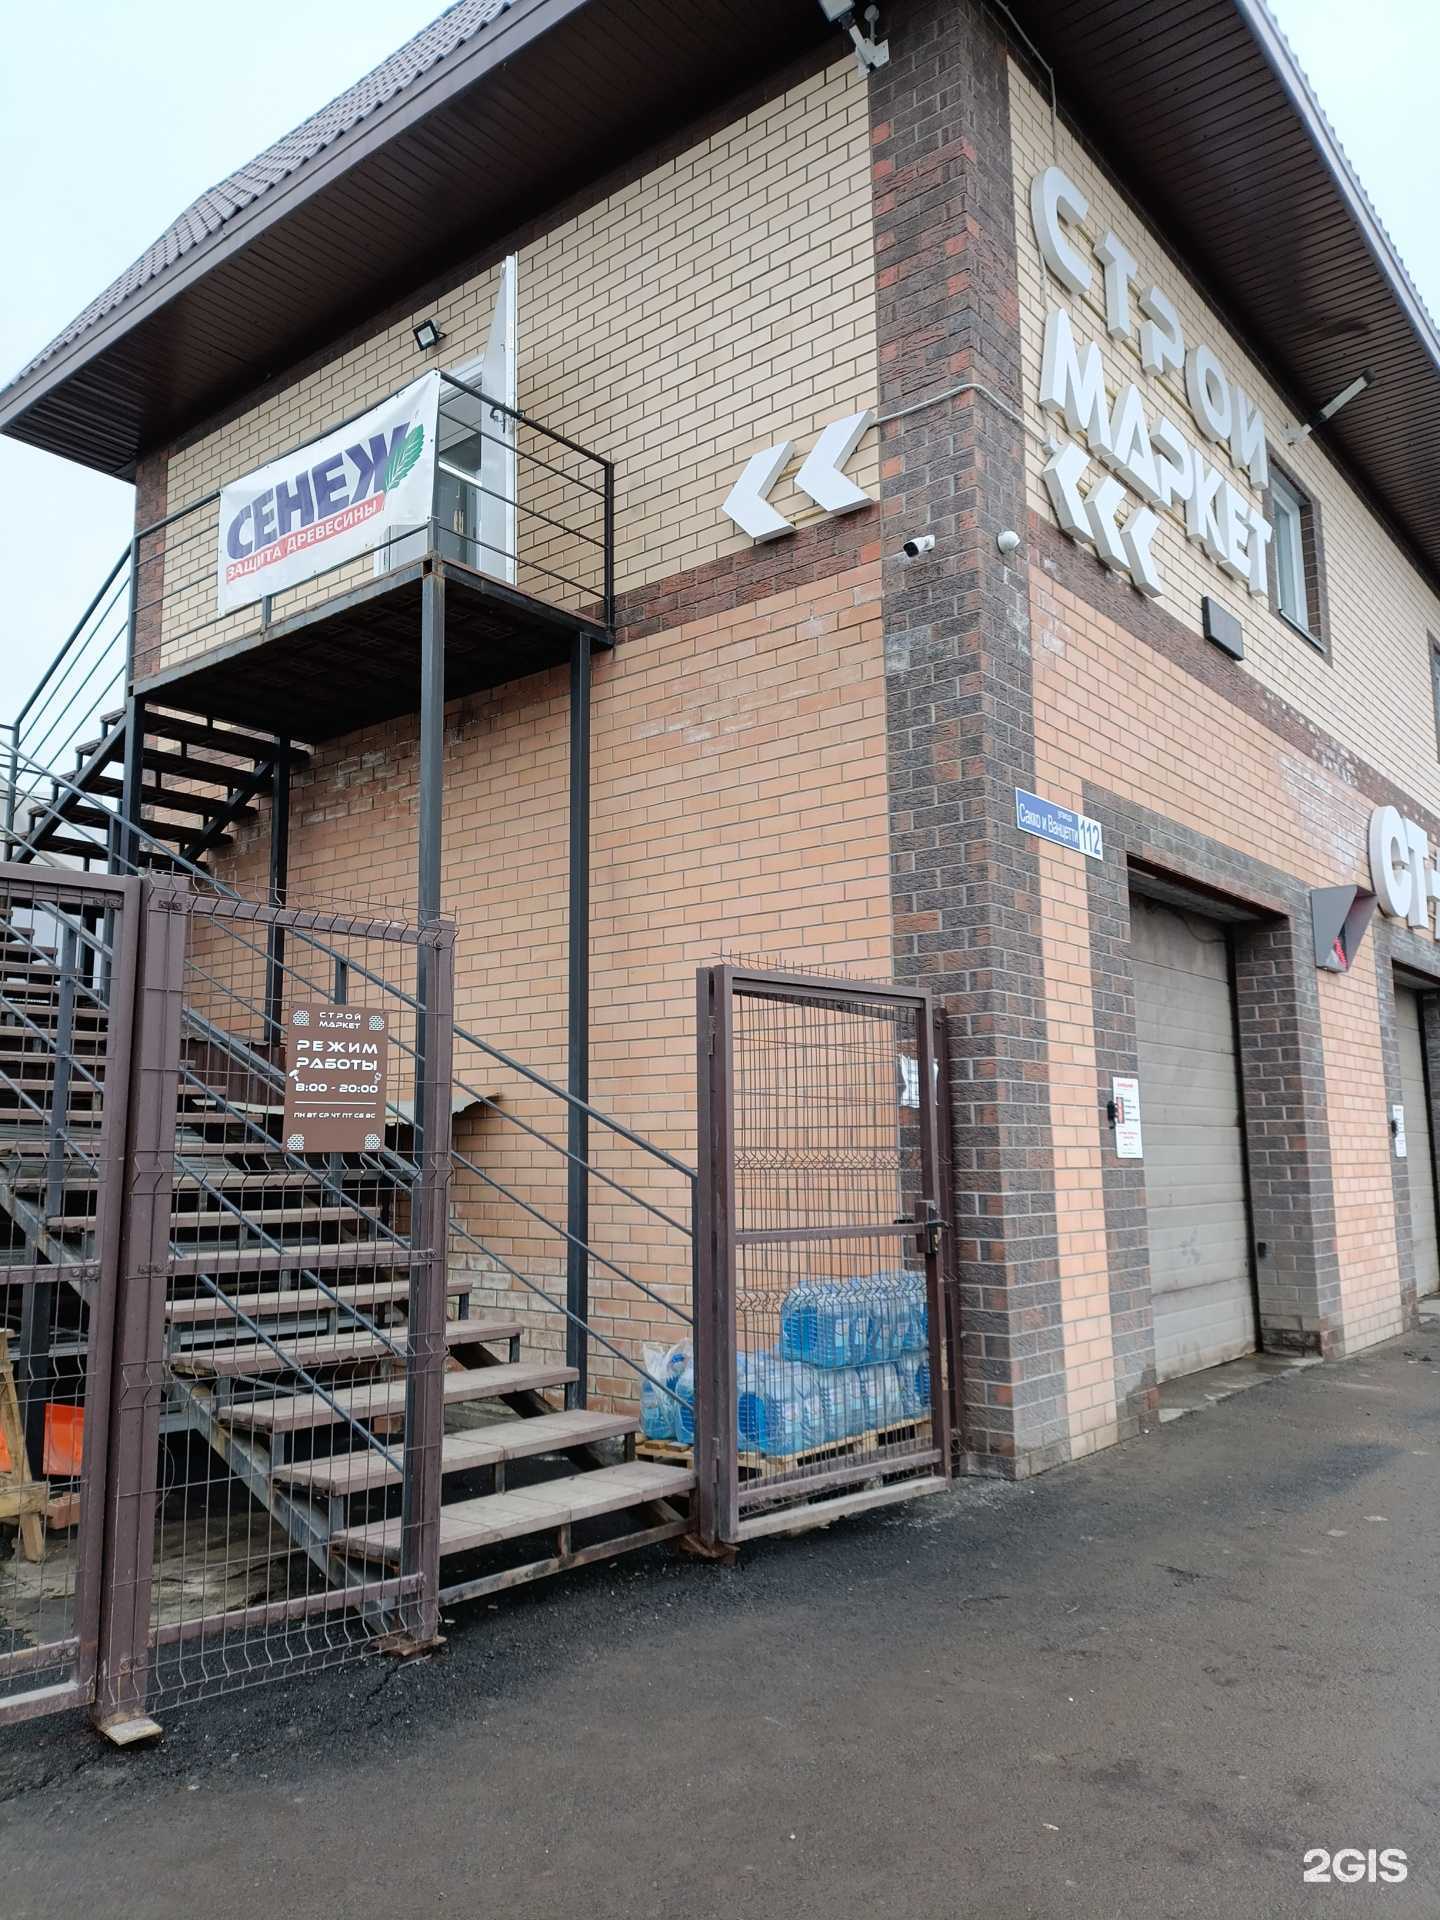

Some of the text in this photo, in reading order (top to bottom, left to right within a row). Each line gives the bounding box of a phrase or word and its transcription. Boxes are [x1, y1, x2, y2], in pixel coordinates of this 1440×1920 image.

[1040, 308, 1272, 597] МАРКЕТ
[227, 421, 412, 560] СЕНЕЖ
[227, 501, 377, 579] ЗАЩИТА ДРЕВЕСИНЫ
[1080, 818, 1101, 855] 112
[319, 1011, 361, 1021] СТРОЙ
[319, 1021, 361, 1029] МАРКЕТ
[296, 1040, 378, 1054] РЕЖИМ
[296, 1057, 378, 1071] РАБОТЫ
[295, 1083, 328, 1092] 8:00
[339, 1084, 378, 1093] 20:00
